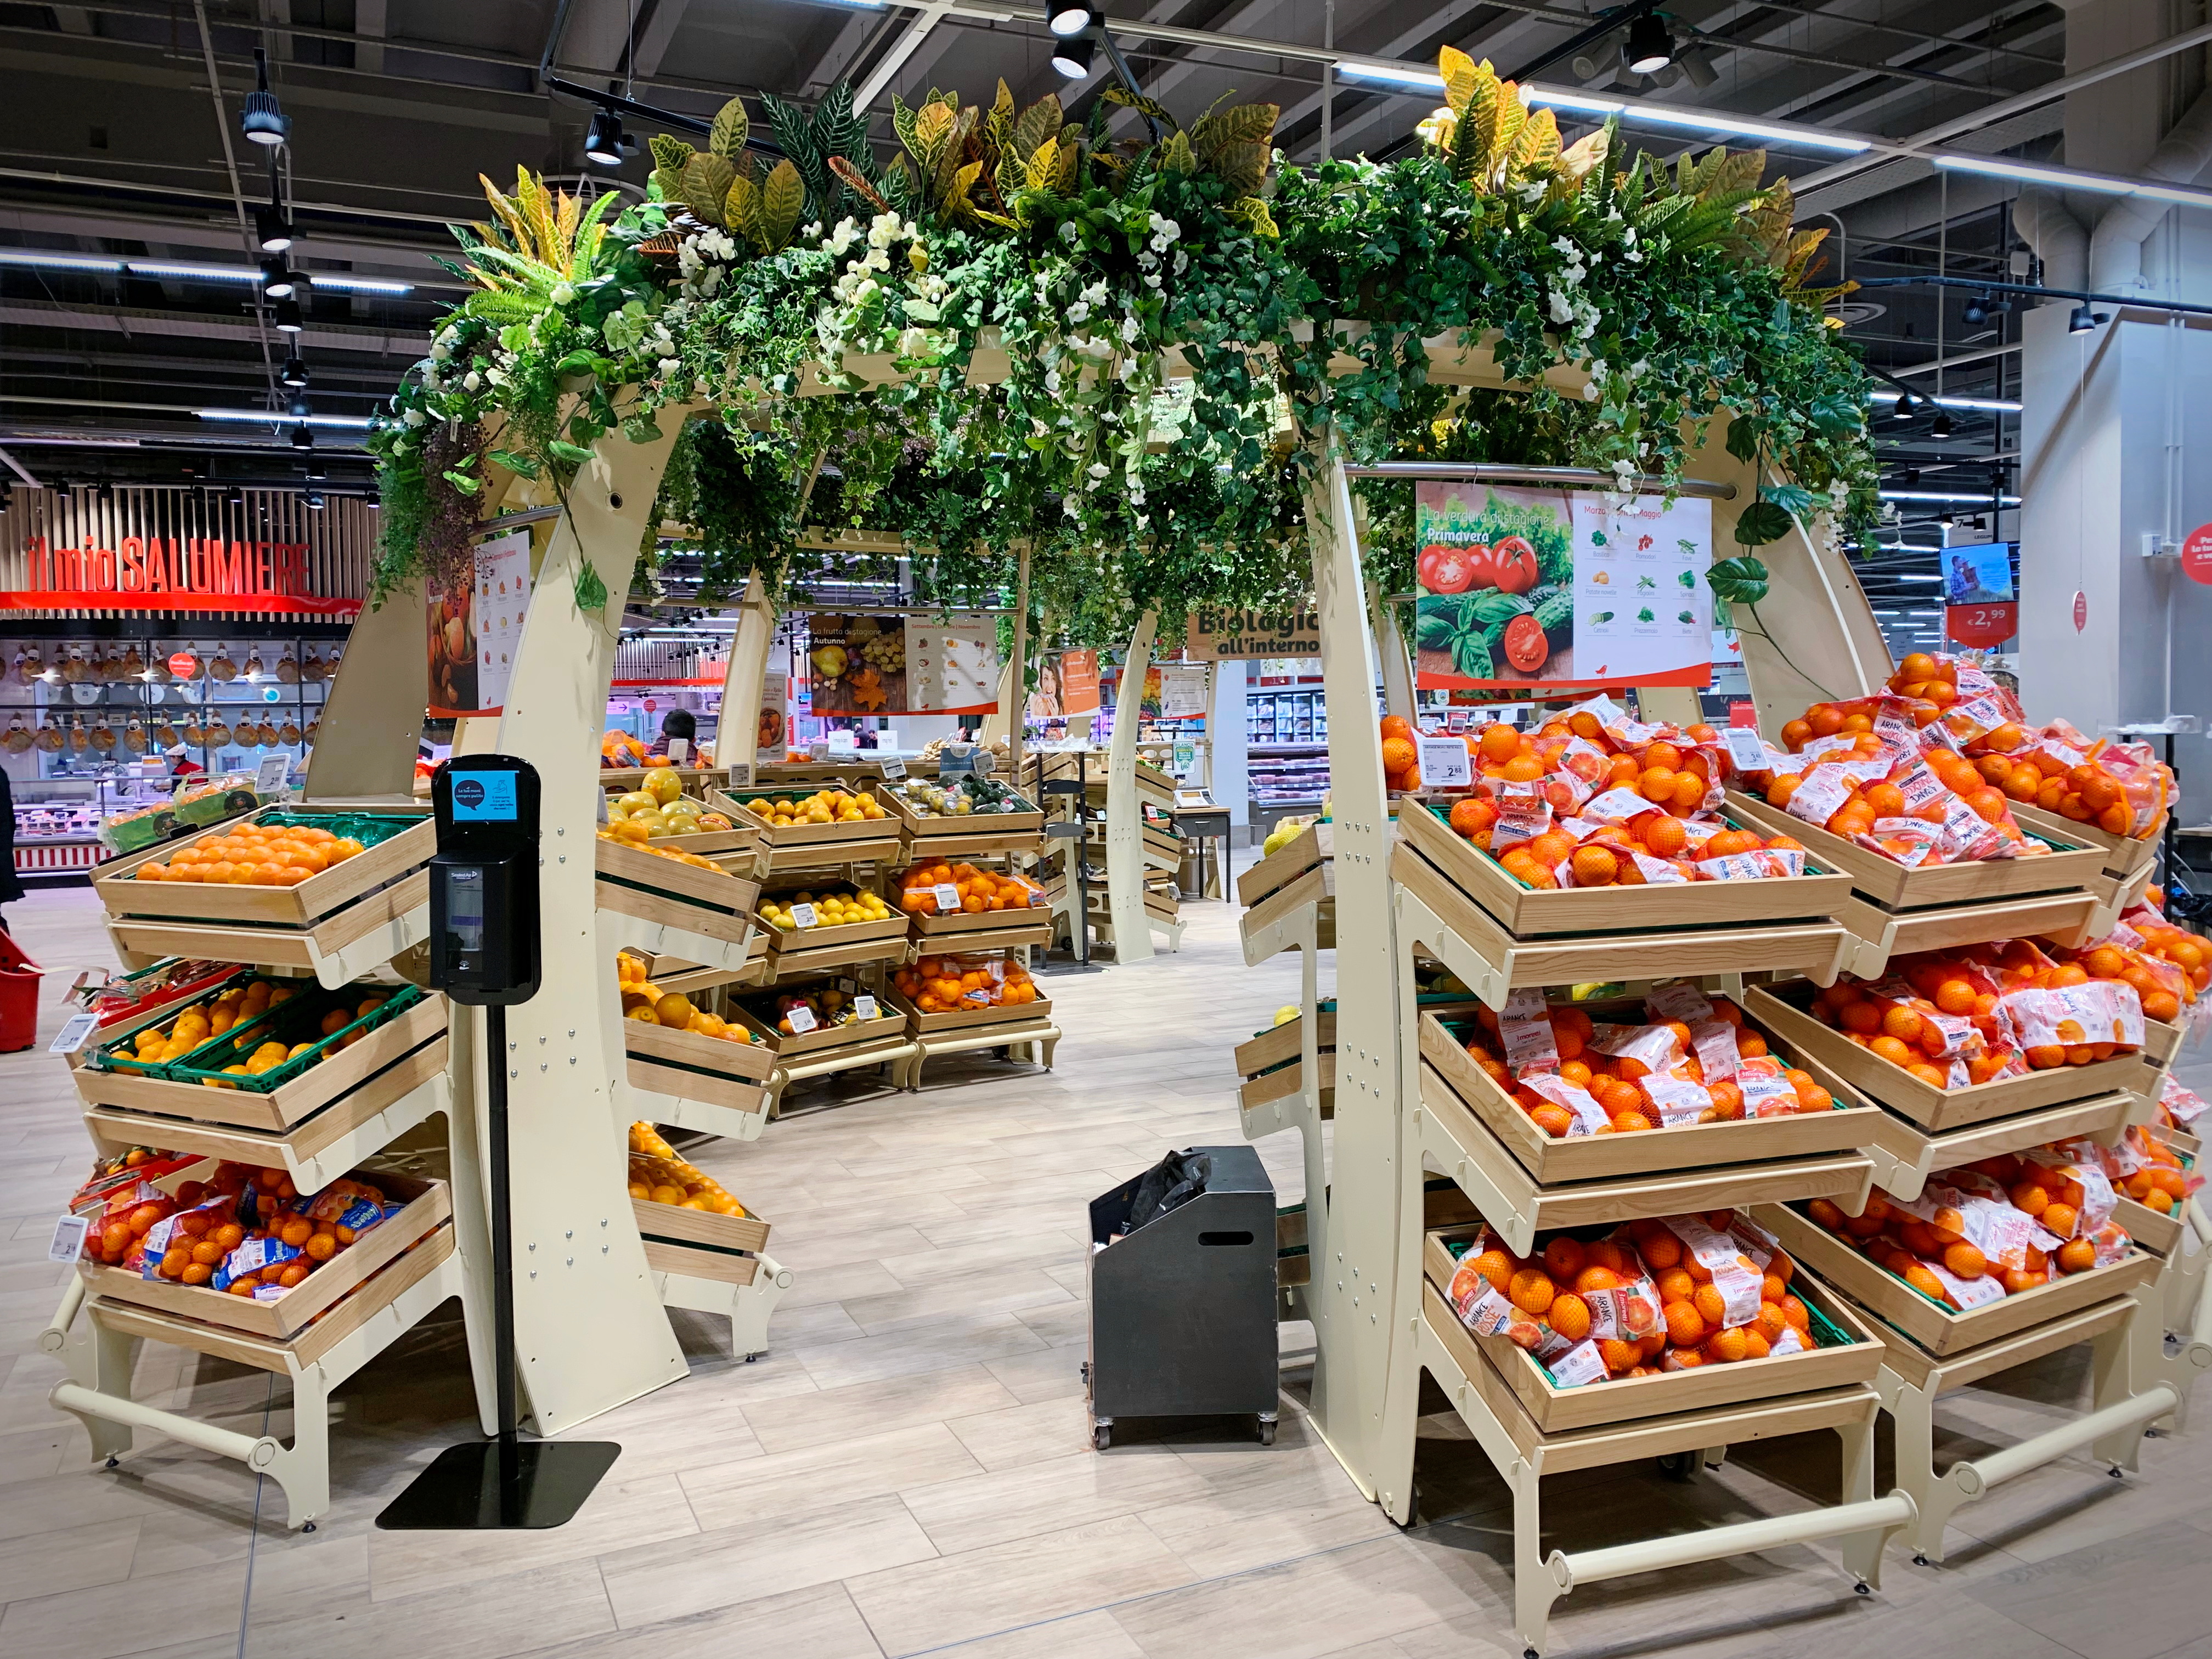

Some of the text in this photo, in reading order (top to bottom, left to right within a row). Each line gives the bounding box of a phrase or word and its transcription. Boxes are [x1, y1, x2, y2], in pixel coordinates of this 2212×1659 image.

[1426, 507, 1549, 528] La verdura di stagione
[1584, 505, 1606, 515] Marzo
[1639, 509, 1662, 520] Maggio
[1427, 527, 1489, 543] Primavera
[28, 535, 312, 596] il mio SALUMIERE
[813, 627, 882, 637] La frutta di stagione
[814, 636, 846, 645] Autunno
[1217, 637, 1319, 654] all'interno
[1469, 1301, 1488, 1327] ARANCE
[1596, 1296, 1613, 1323] ARANCE
[1617, 1291, 1628, 1322] 3moretti
